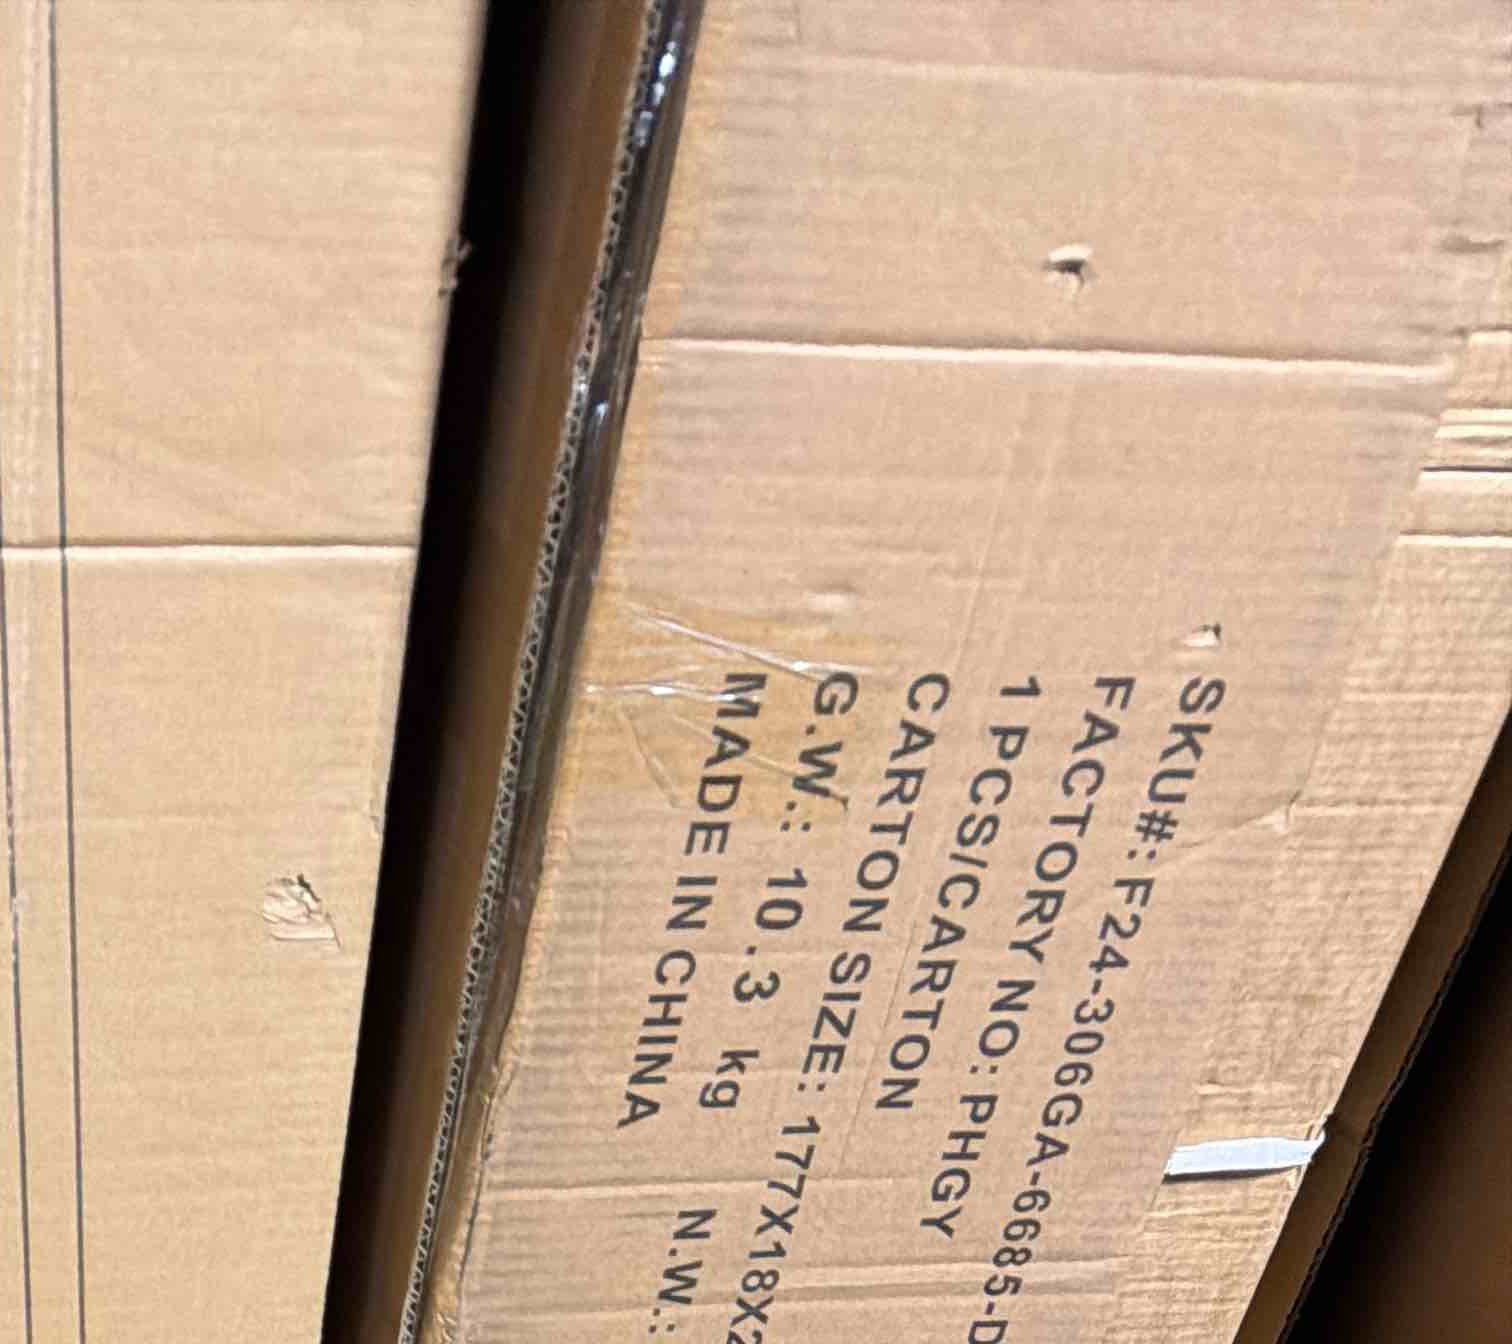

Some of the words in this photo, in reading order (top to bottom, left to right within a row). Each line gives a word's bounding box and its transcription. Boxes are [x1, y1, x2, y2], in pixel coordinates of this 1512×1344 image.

[780, 671, 859, 832] G.W.:
[999, 676, 1042, 697] 1
[684, 673, 768, 856] MADE
[842, 673, 951, 932] CARTON
[1008, 677, 1137, 965] FACTORY
[1127, 677, 1226, 860] SKU#:
[665, 876, 718, 931] IN
[733, 867, 808, 1003] 10.3
[875, 725, 1030, 1109] PCS/CARTON
[617, 949, 697, 1129] CHINA
[698, 1049, 760, 1109] kg
[797, 951, 872, 1092] SIZE:
[969, 979, 1037, 1075] NO:
[919, 1094, 999, 1239] PHGY
[648, 1208, 718, 1334] N.W.:
